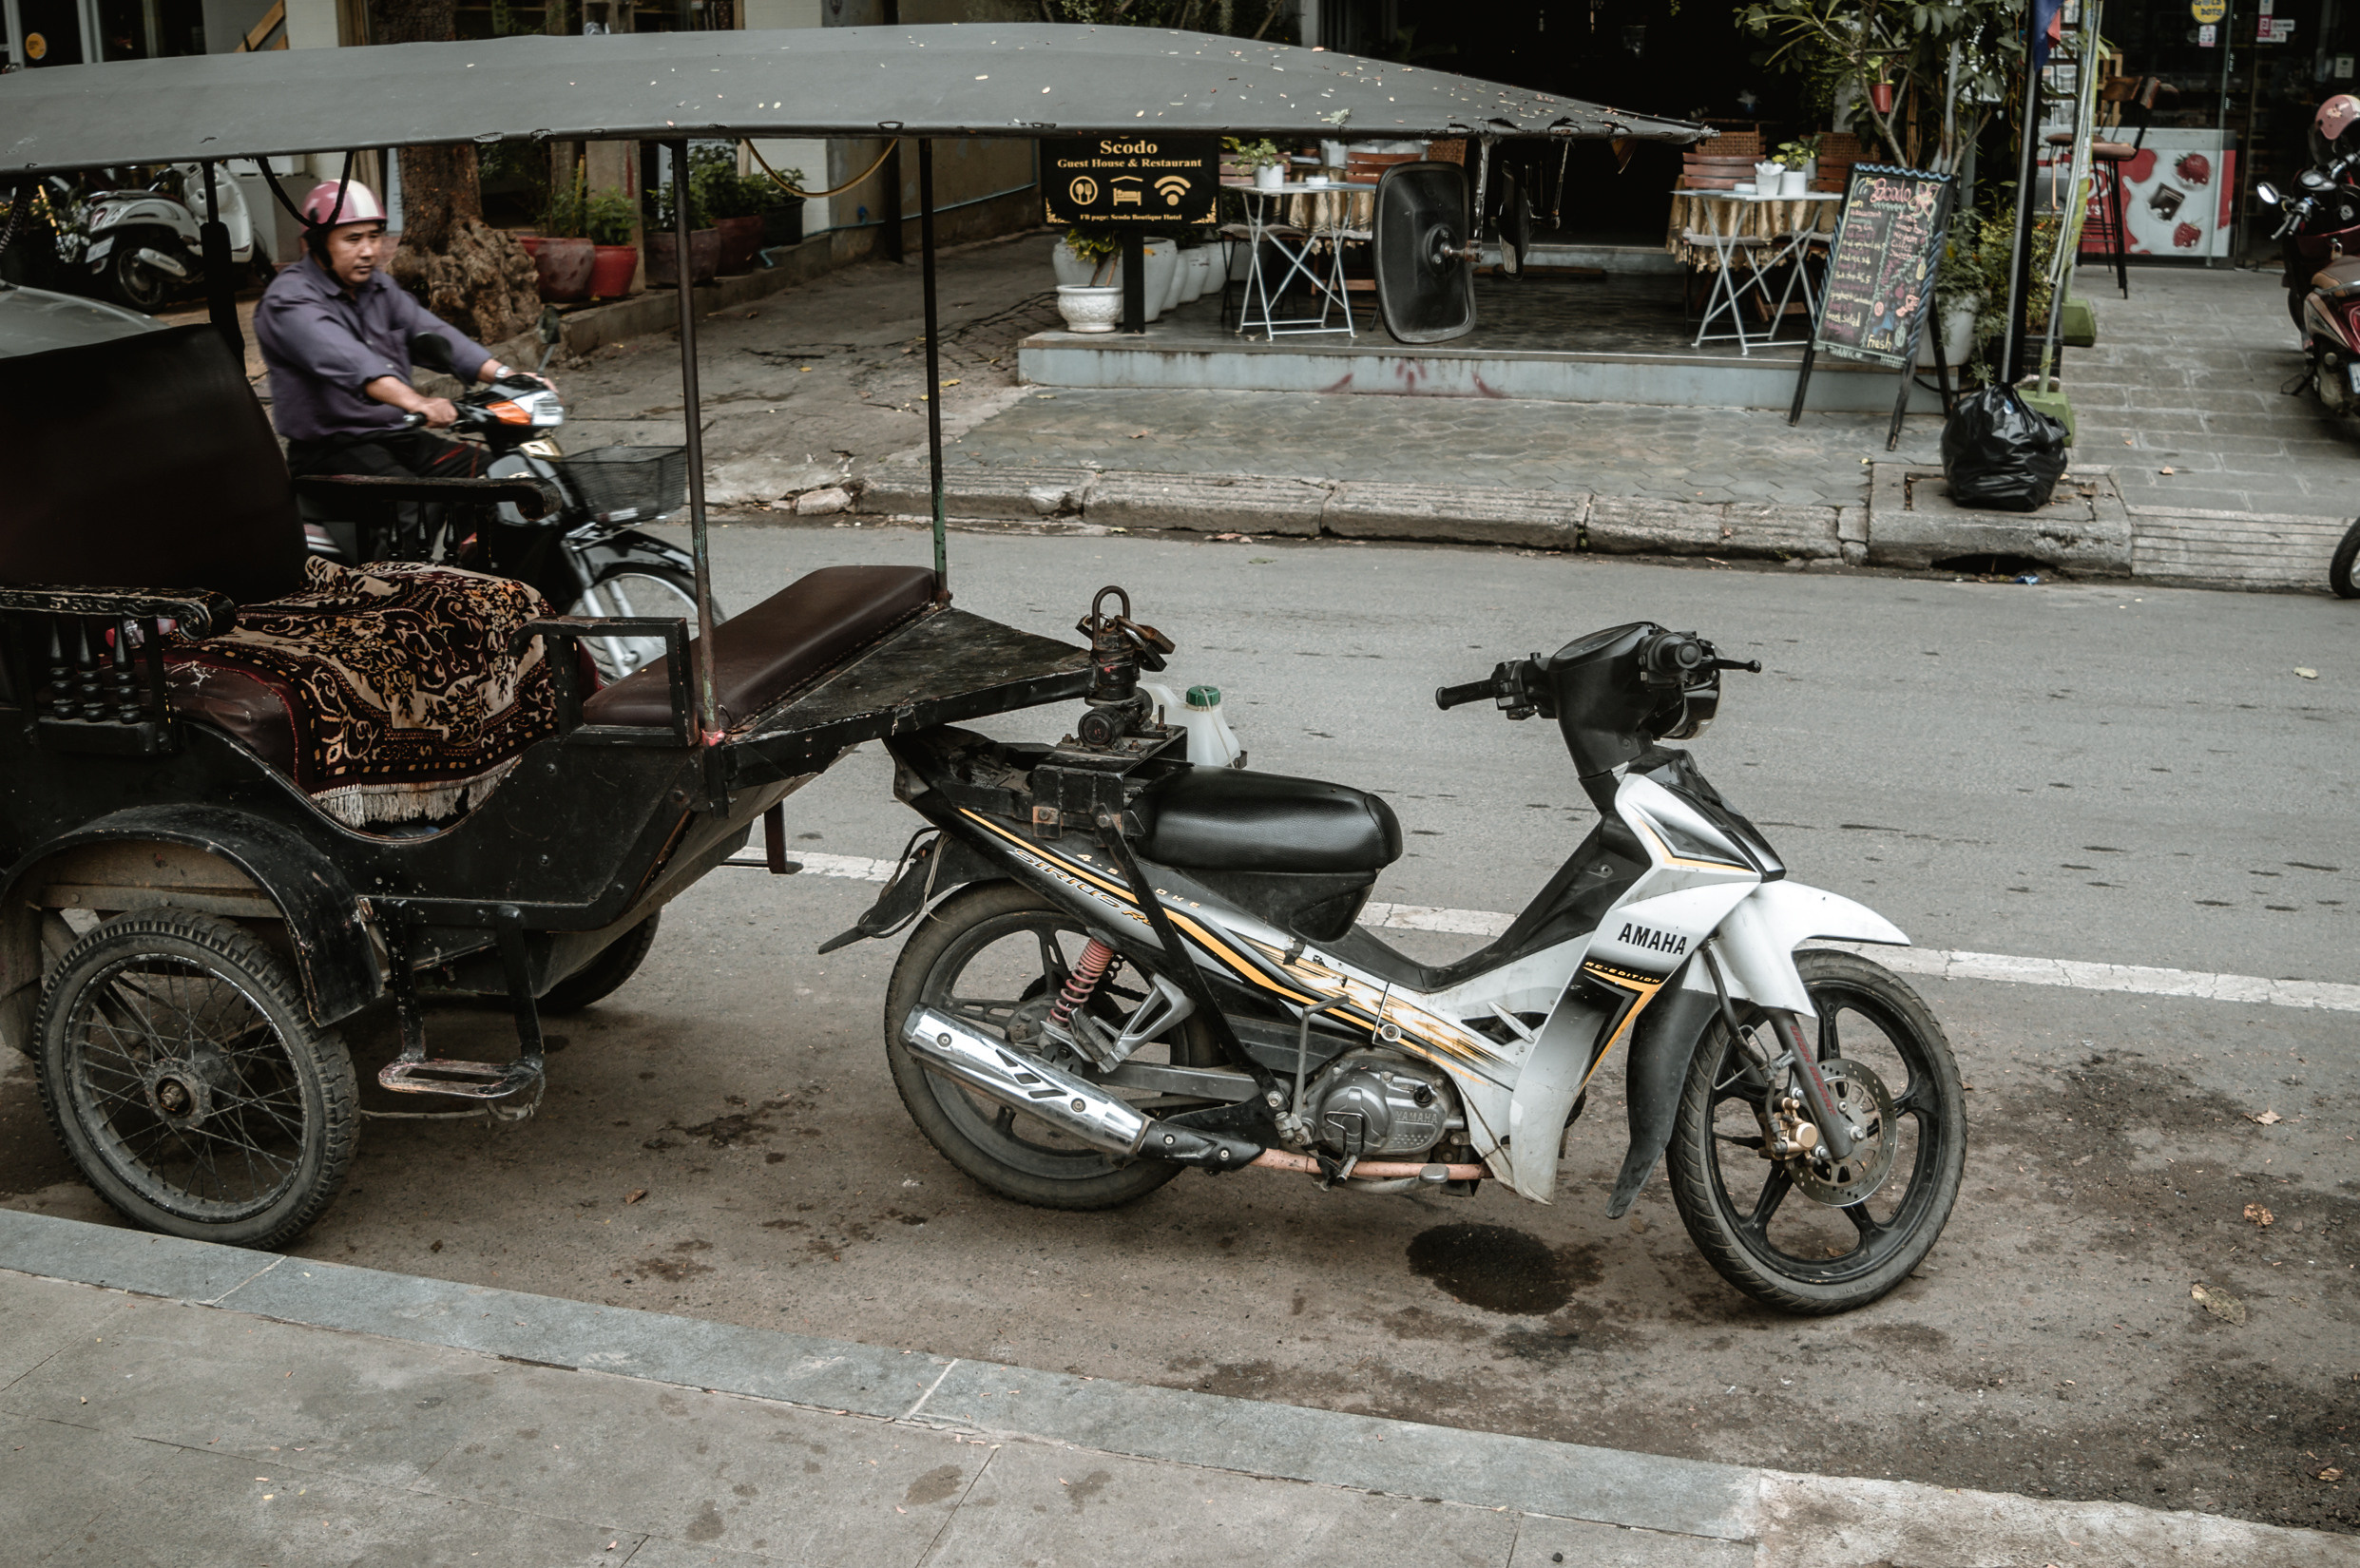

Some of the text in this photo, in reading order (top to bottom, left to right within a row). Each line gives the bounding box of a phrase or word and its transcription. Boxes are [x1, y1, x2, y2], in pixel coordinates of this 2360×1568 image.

[1100, 140, 1158, 155] Scodo
[1057, 159, 1201, 168] Guest House & Restaurant
[1007, 849, 1122, 908] SIRIUS
[1618, 922, 1688, 955] AMAHA
[1396, 1111, 1438, 1123] YAMAHA
